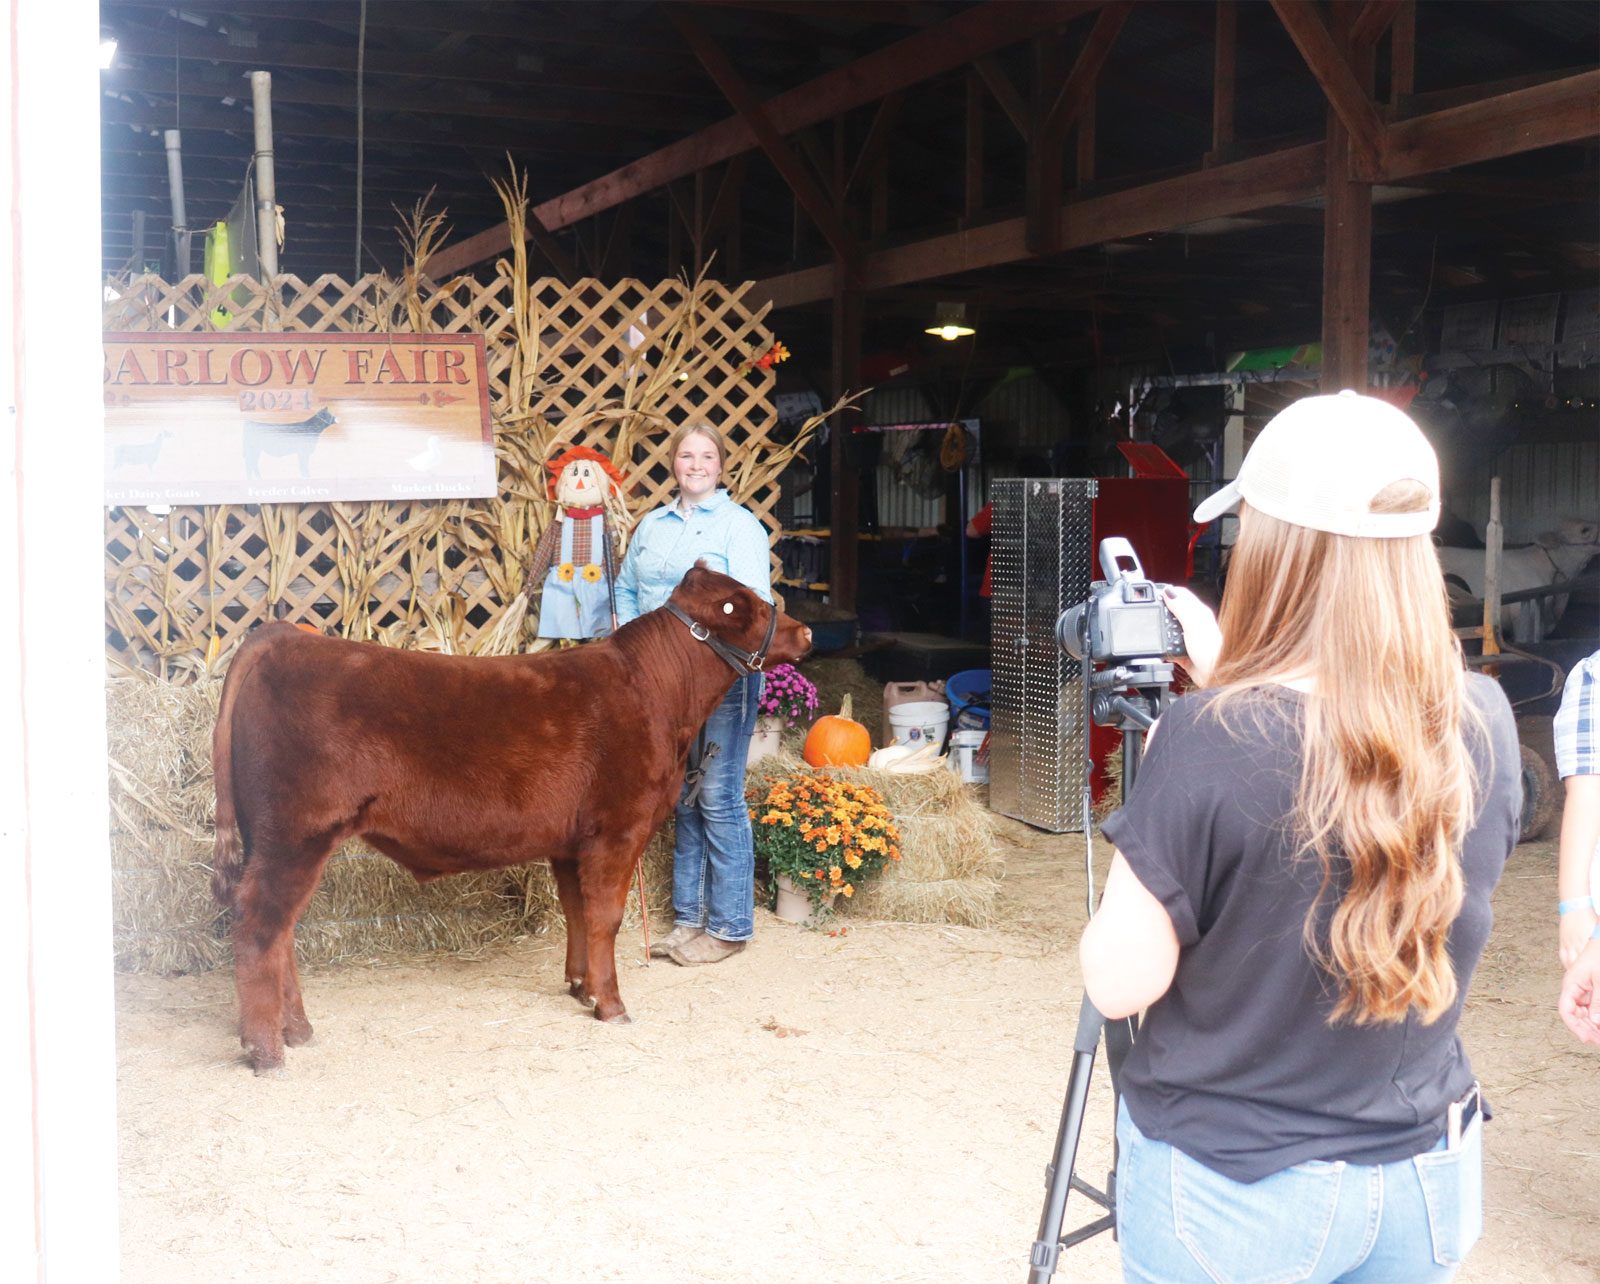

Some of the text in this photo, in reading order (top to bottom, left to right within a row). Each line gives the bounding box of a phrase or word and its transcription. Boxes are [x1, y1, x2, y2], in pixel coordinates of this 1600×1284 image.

[104, 348, 471, 387] ARLOW FAIR
[128, 487, 161, 502] Dairy
[164, 487, 201, 499] Goats
[247, 485, 330, 497] Feeder Calves
[391, 482, 472, 494] Market Ducks
